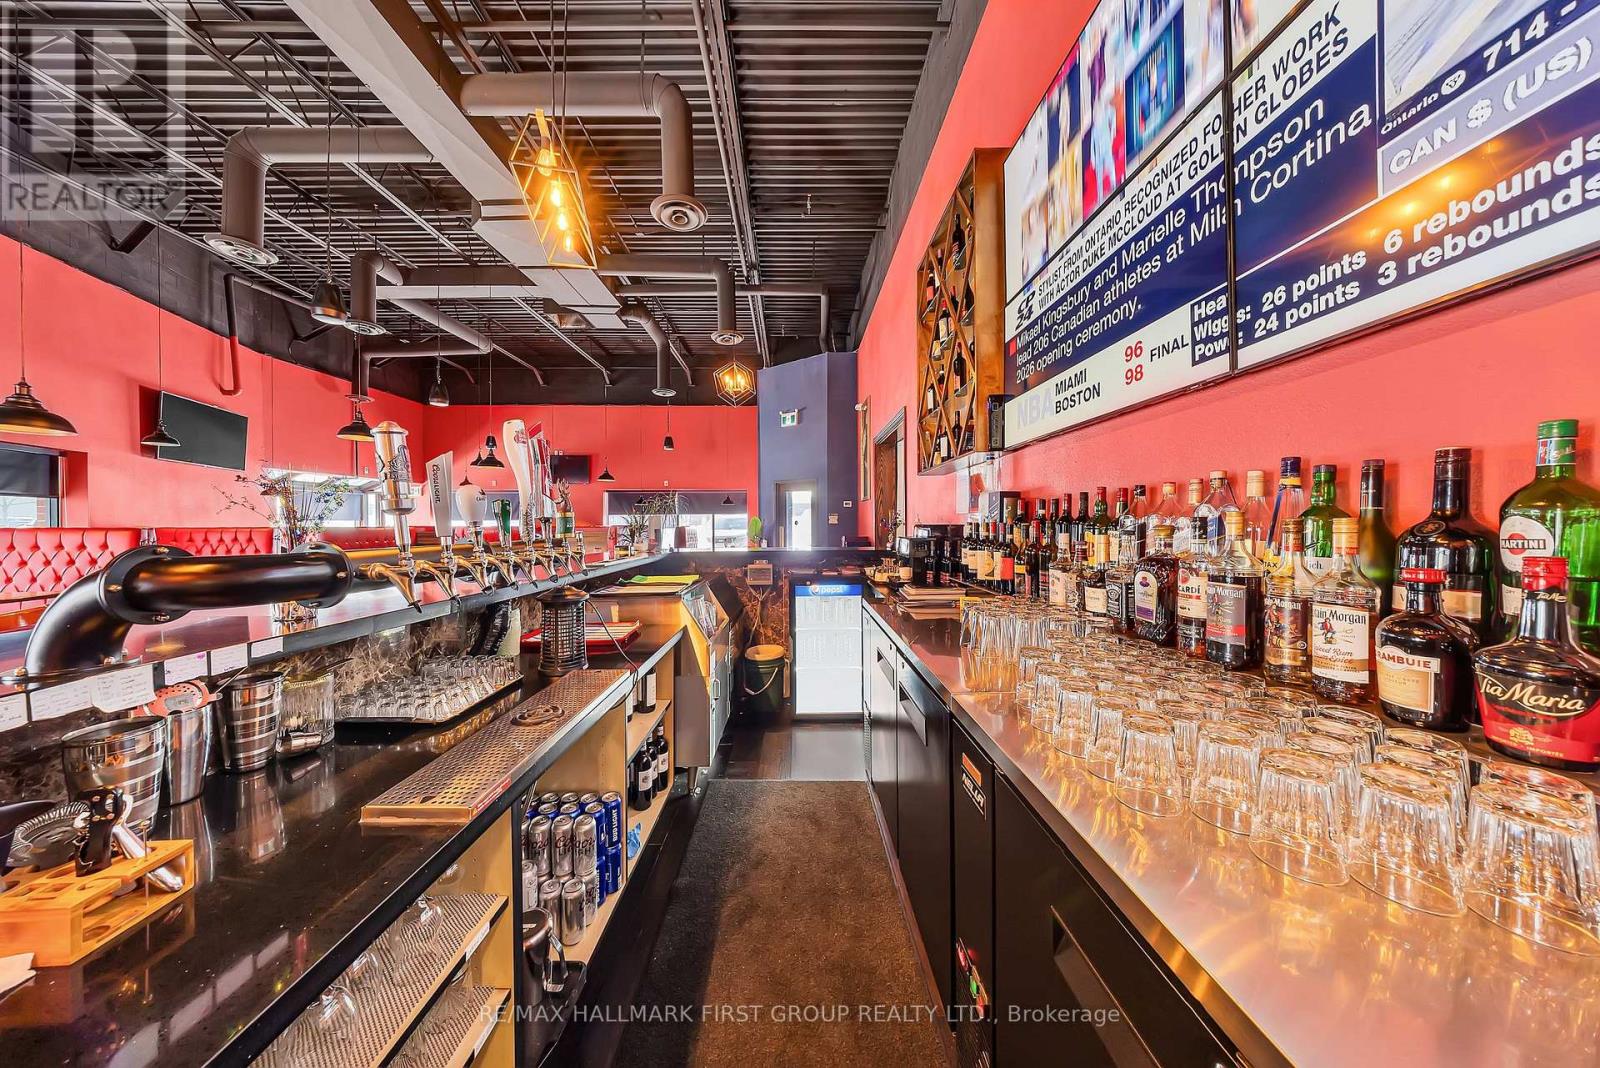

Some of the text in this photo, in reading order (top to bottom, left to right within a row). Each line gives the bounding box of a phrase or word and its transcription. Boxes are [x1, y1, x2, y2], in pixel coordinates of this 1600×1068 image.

[1483, 10, 1548, 73] 714
[1389, 36, 1593, 174] CAN $ (US)
[1038, 1, 1341, 296] STYLIST FROM ONTARIO RECOGNIZED FO HER WORK
[1038, 27, 1349, 311] WITH ACTOR DUKE MCCLOUD AT GOLN GLOBES
[1017, 344, 1032, 367] lead
[1033, 332, 1049, 356] 206
[1051, 299, 1100, 342] Canadian
[1103, 257, 1161, 307] athletes
[1166, 235, 1184, 265] at
[1251, 103, 1372, 203] Cortina
[1262, 285, 1287, 313] 26
[1292, 249, 1367, 303] points
[1383, 229, 1403, 255] 6
[1412, 134, 1600, 243] rebounds
[1017, 319, 1041, 350] Mikael
[1042, 282, 1091, 330] Kingsbury
[1093, 256, 1119, 290] and
[1122, 206, 1187, 267] Marielle
[1254, 312, 1279, 339] 24
[1285, 277, 1361, 329] points
[1377, 260, 1397, 286] 3
[1407, 172, 1600, 275] rebounds
[1014, 304, 1034, 332] 24
[1017, 290, 1036, 315] CP
[1194, 293, 1228, 322] Hea
[1016, 296, 1142, 385] 2026 opening ceremony.
[1055, 334, 1190, 396] MIAMI 96 FINAL
[1017, 389, 1054, 430] NBA
[1055, 363, 1144, 414] BOSTON 98
[1217, 587, 1243, 598] Morgan
[1275, 598, 1301, 610] Morgan
[1329, 609, 1367, 625] Morgan
[1377, 650, 1432, 669] RAMBUIE
[1479, 673, 1585, 712] Tia Maria
